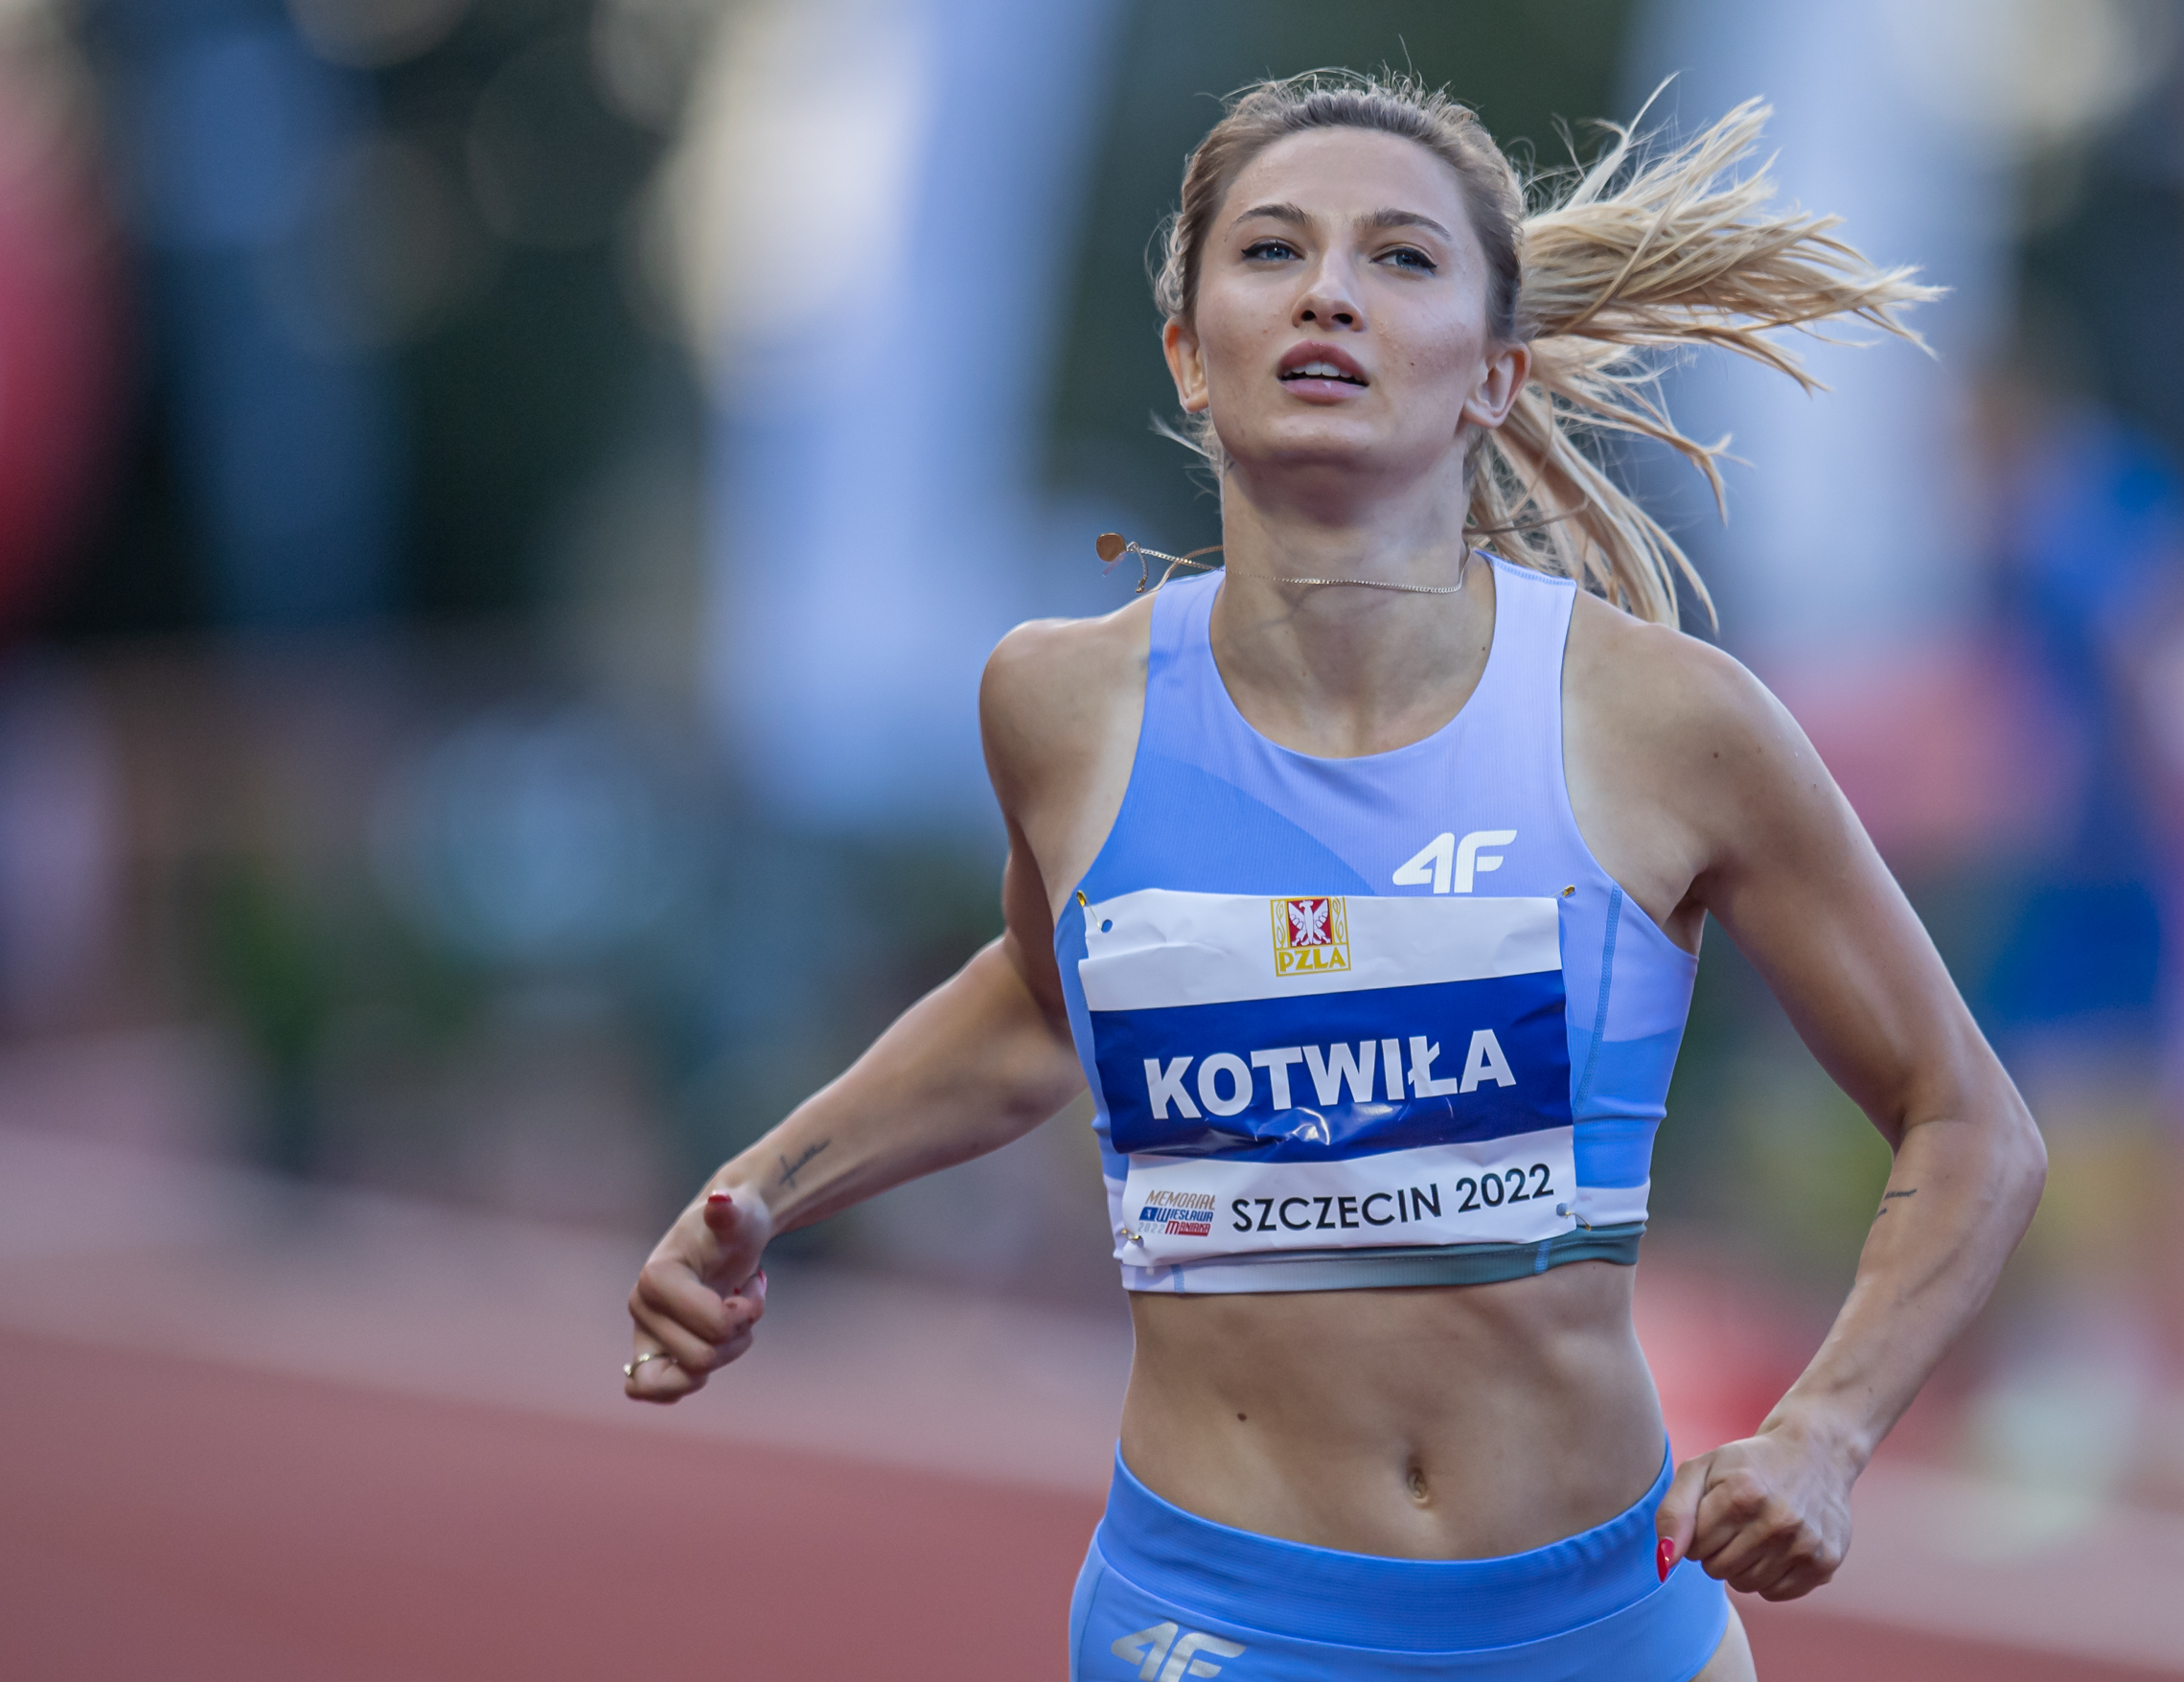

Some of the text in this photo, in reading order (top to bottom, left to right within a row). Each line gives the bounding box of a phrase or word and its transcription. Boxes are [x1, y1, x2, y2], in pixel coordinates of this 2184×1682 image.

[1392, 830, 1518, 894] 4F
[1277, 947, 1346, 972] PZLA
[1143, 1028, 1517, 1119] KOTWIŁA
[1145, 1189, 1215, 1210] MEMORIAŁ
[1231, 1164, 1554, 1233] SZCZECIN 2022
